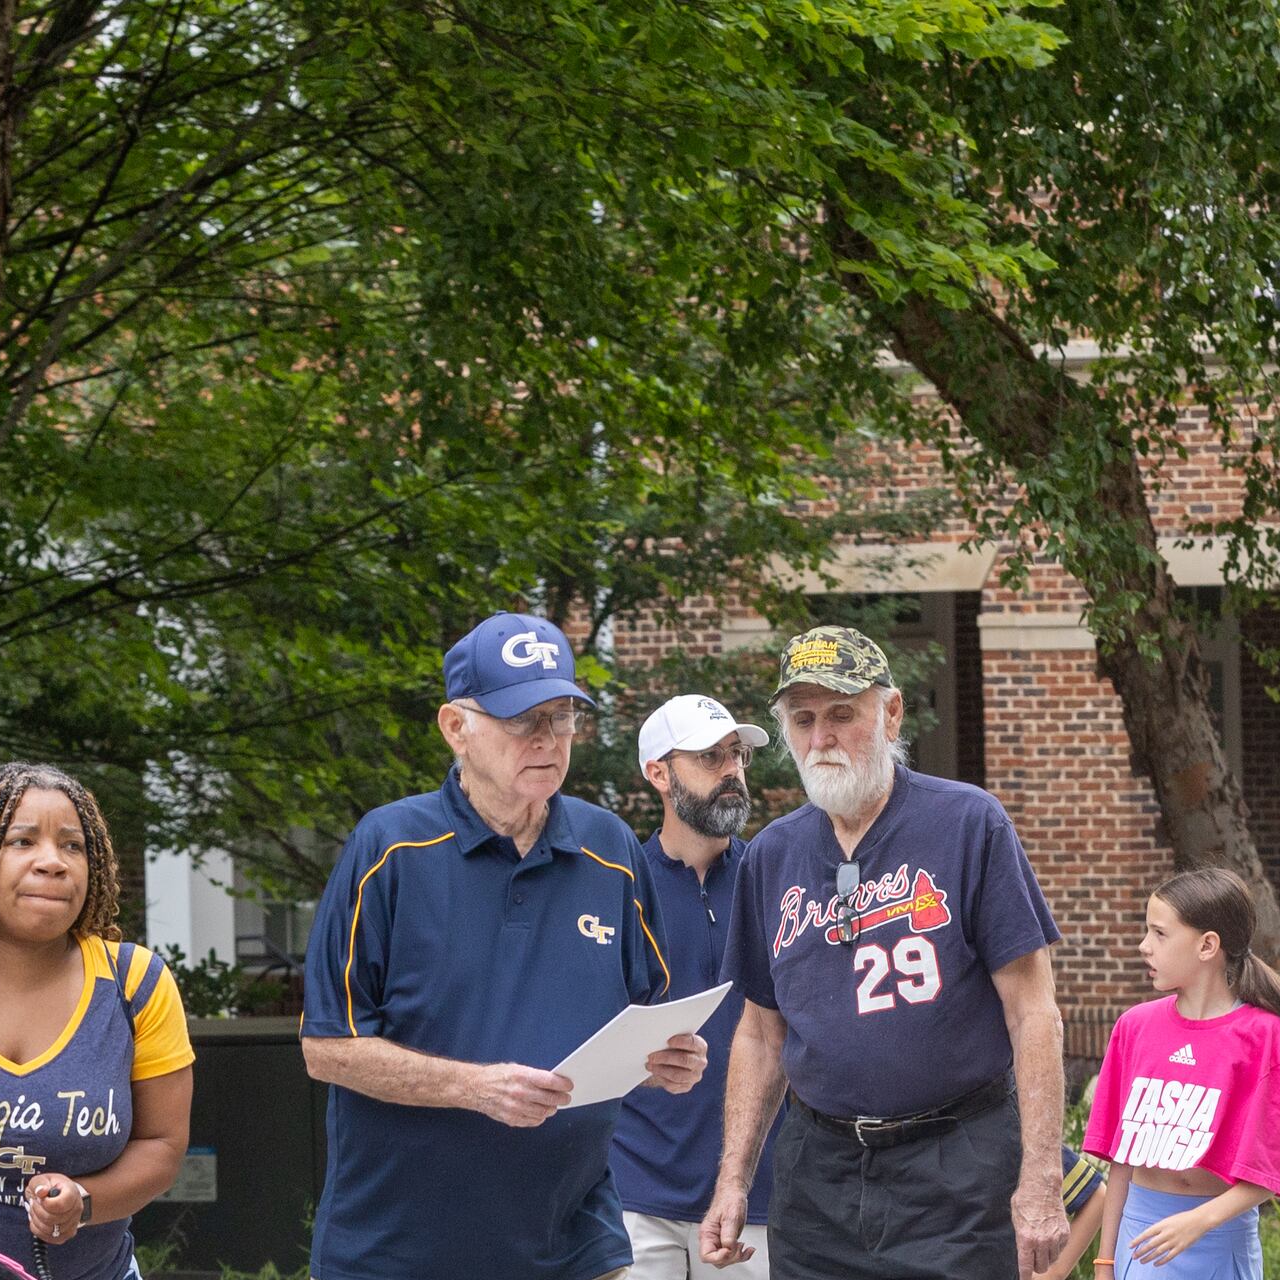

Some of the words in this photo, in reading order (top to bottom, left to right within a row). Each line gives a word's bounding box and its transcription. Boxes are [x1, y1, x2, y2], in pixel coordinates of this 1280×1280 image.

[790, 656, 833, 668] VETERAN
[793, 640, 838, 654] VIETNAM
[577, 914, 615, 945] GT
[853, 934, 942, 1015] 29
[1168, 1055, 1197, 1066] adidas
[1122, 1077, 1222, 1132] TASHA
[1113, 1120, 1215, 1171] TOUGH
